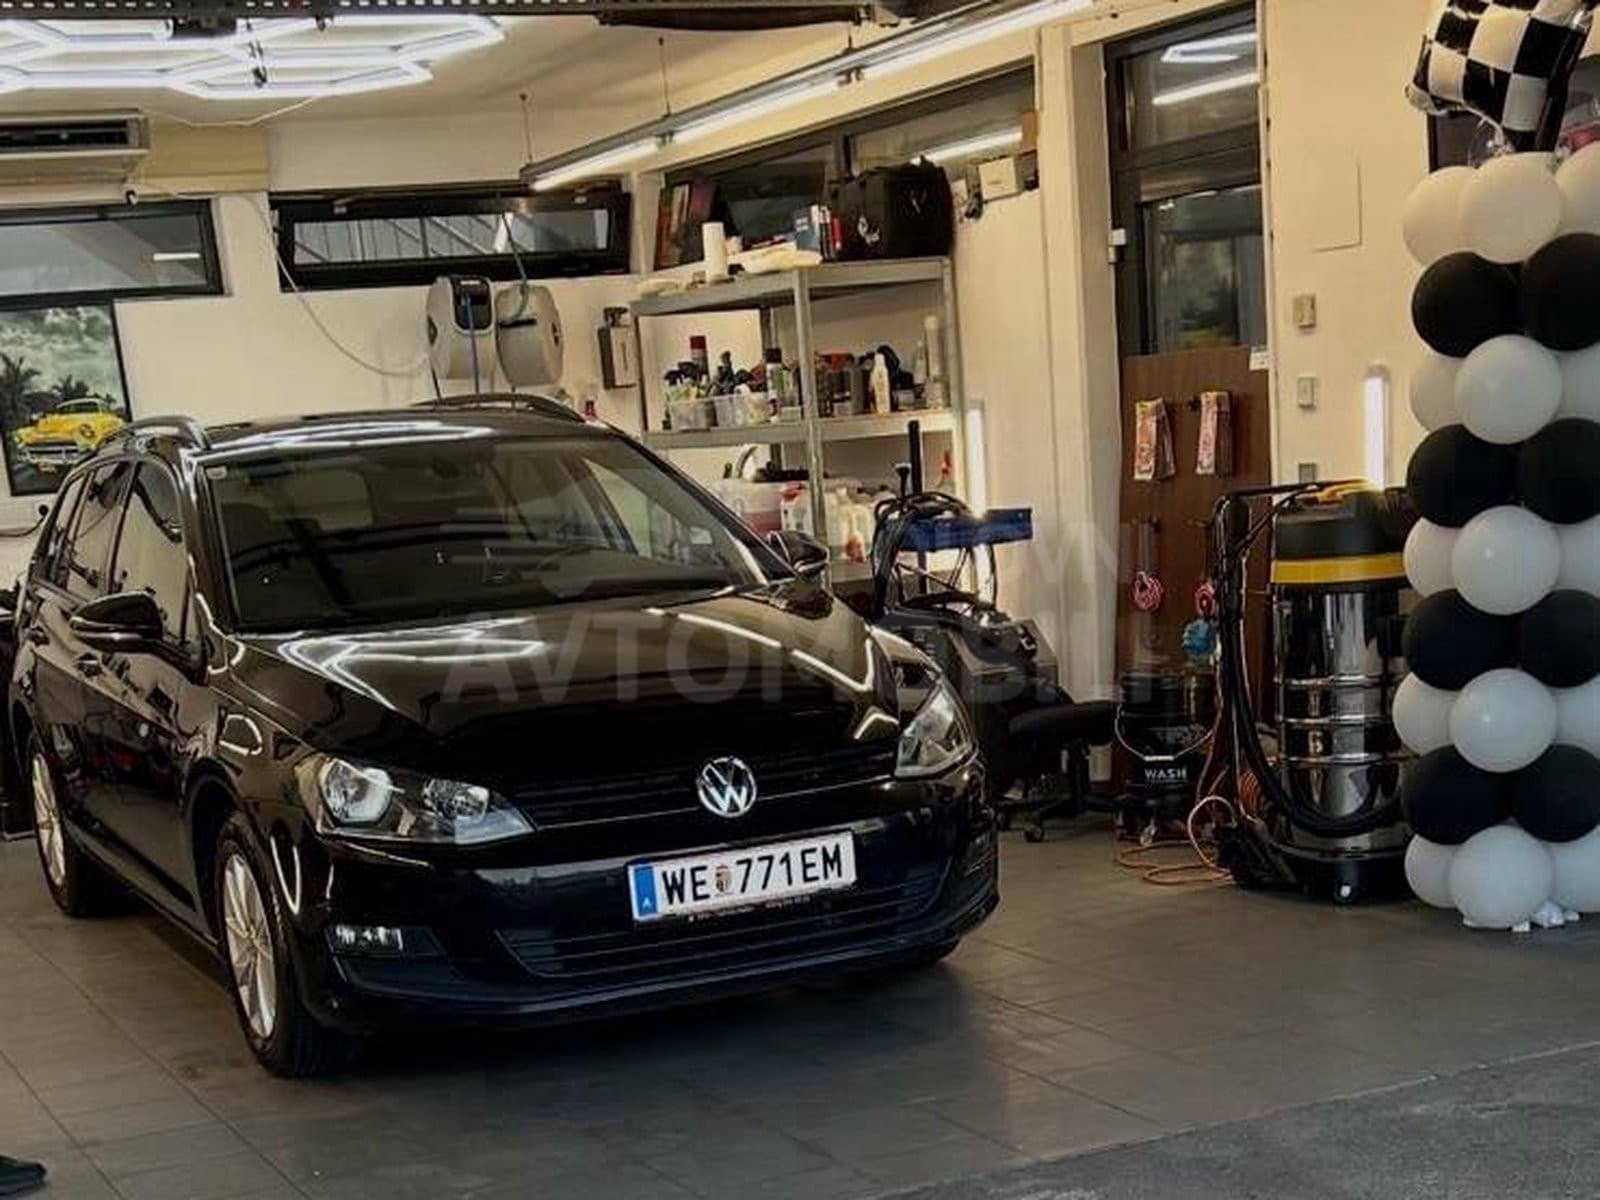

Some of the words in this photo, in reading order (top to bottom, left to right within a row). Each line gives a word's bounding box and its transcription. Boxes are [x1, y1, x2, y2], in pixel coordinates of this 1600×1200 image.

[1144, 768, 1188, 781] WASH
[661, 865, 711, 906] WE
[735, 843, 842, 894] 771EM
